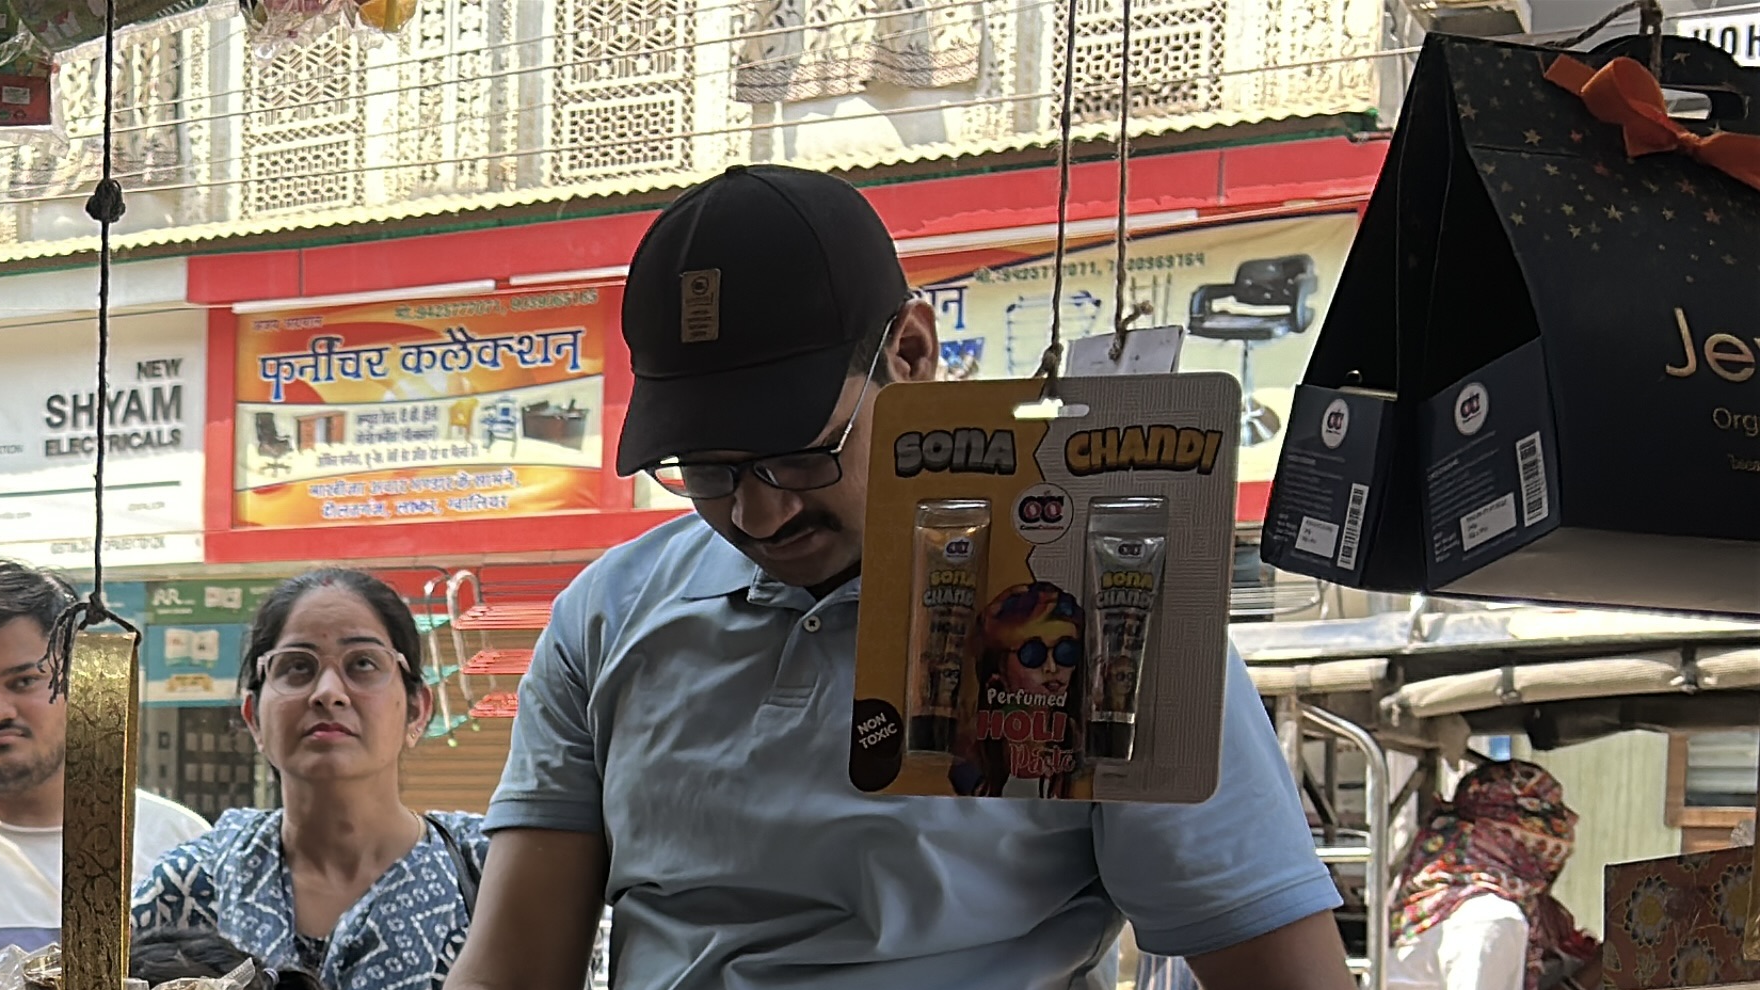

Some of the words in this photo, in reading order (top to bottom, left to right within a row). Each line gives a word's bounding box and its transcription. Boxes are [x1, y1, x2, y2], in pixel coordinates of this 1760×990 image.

[1665, 306, 1760, 382] Je
[136, 358, 184, 380] NEW
[259, 335, 391, 401] फर्नीचर
[45, 385, 183, 429] SHYAM
[893, 427, 1017, 479] SONA
[1064, 424, 1224, 477] CHANDI
[987, 686, 1067, 708] Perfumed
[857, 711, 888, 735] NON
[858, 722, 899, 750] TOXIC
[976, 710, 1068, 741] HOLI
